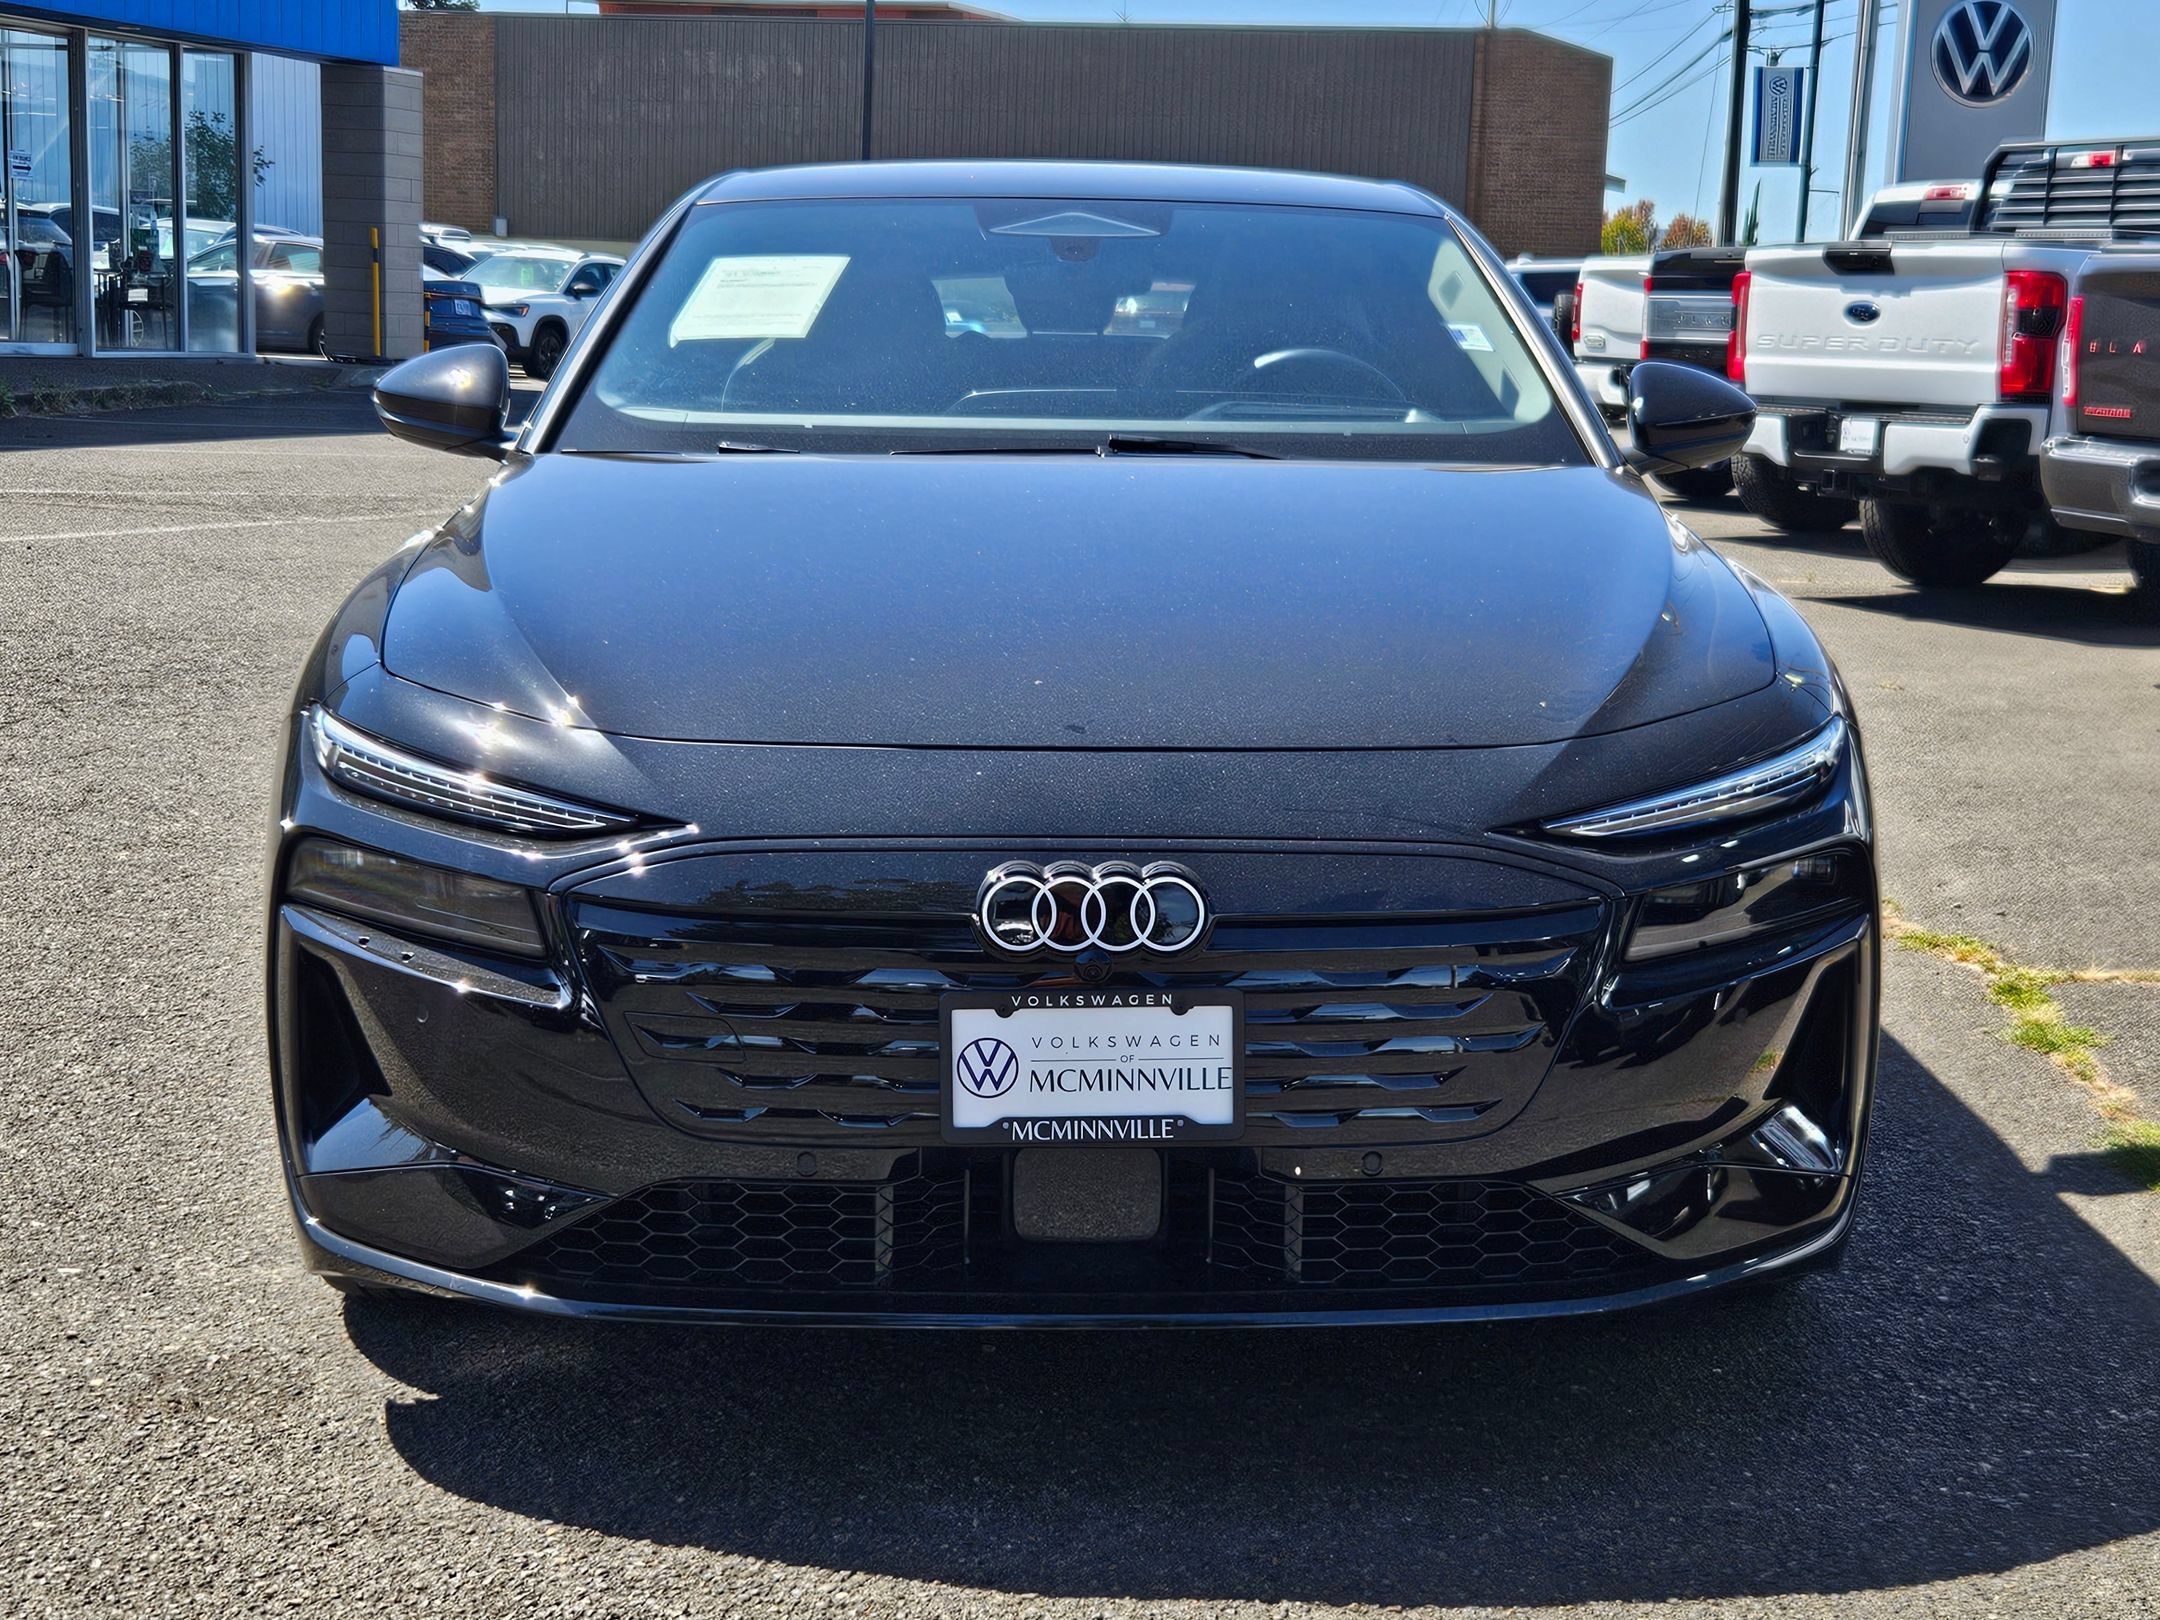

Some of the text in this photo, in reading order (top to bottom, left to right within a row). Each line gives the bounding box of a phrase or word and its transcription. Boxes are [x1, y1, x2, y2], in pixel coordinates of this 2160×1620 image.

[1757, 334, 1981, 355] SUPER DUTY
[1011, 994, 1173, 1007] VOLKSWAGEN
[1031, 1034, 1221, 1049] VOLKSWAGEN
[1120, 1054, 1135, 1064] OF
[1029, 1066, 1232, 1093] MCMINNVILLE
[1012, 1118, 1174, 1141] MCMINNVILLE
